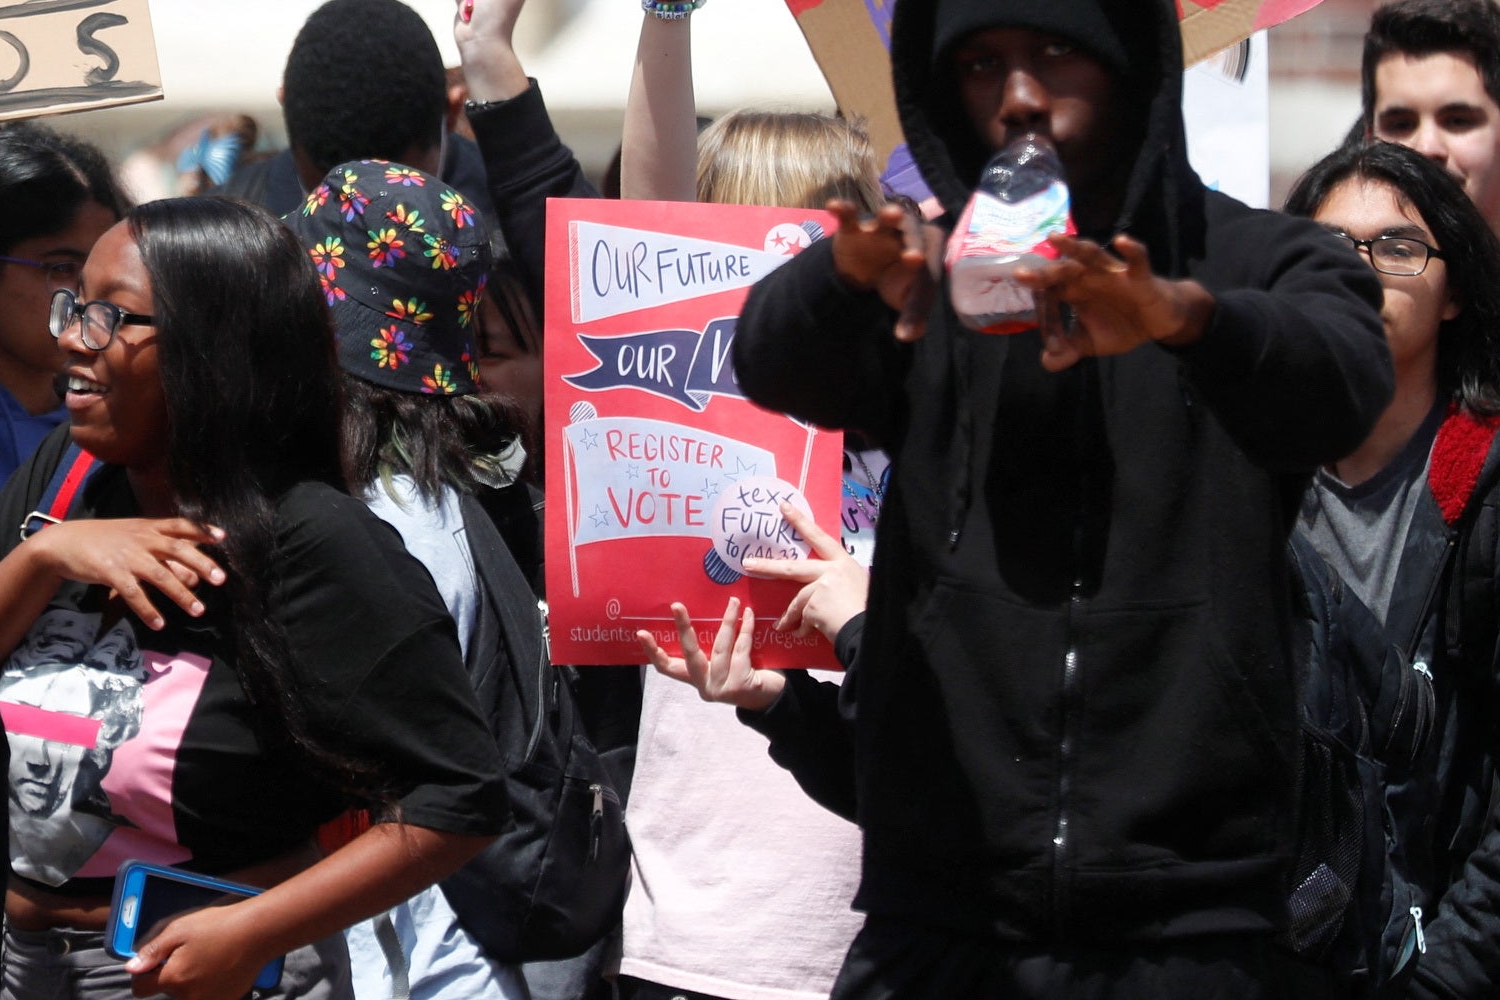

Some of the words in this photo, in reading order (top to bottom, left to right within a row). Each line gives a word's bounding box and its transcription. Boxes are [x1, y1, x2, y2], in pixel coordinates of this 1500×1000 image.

[591, 239, 651, 298] OUR
[656, 247, 751, 298] FUTURE
[617, 344, 677, 387] OUR
[605, 429, 724, 469] REGISTER
[648, 468, 671, 488] TO
[607, 486, 705, 529] VOTE
